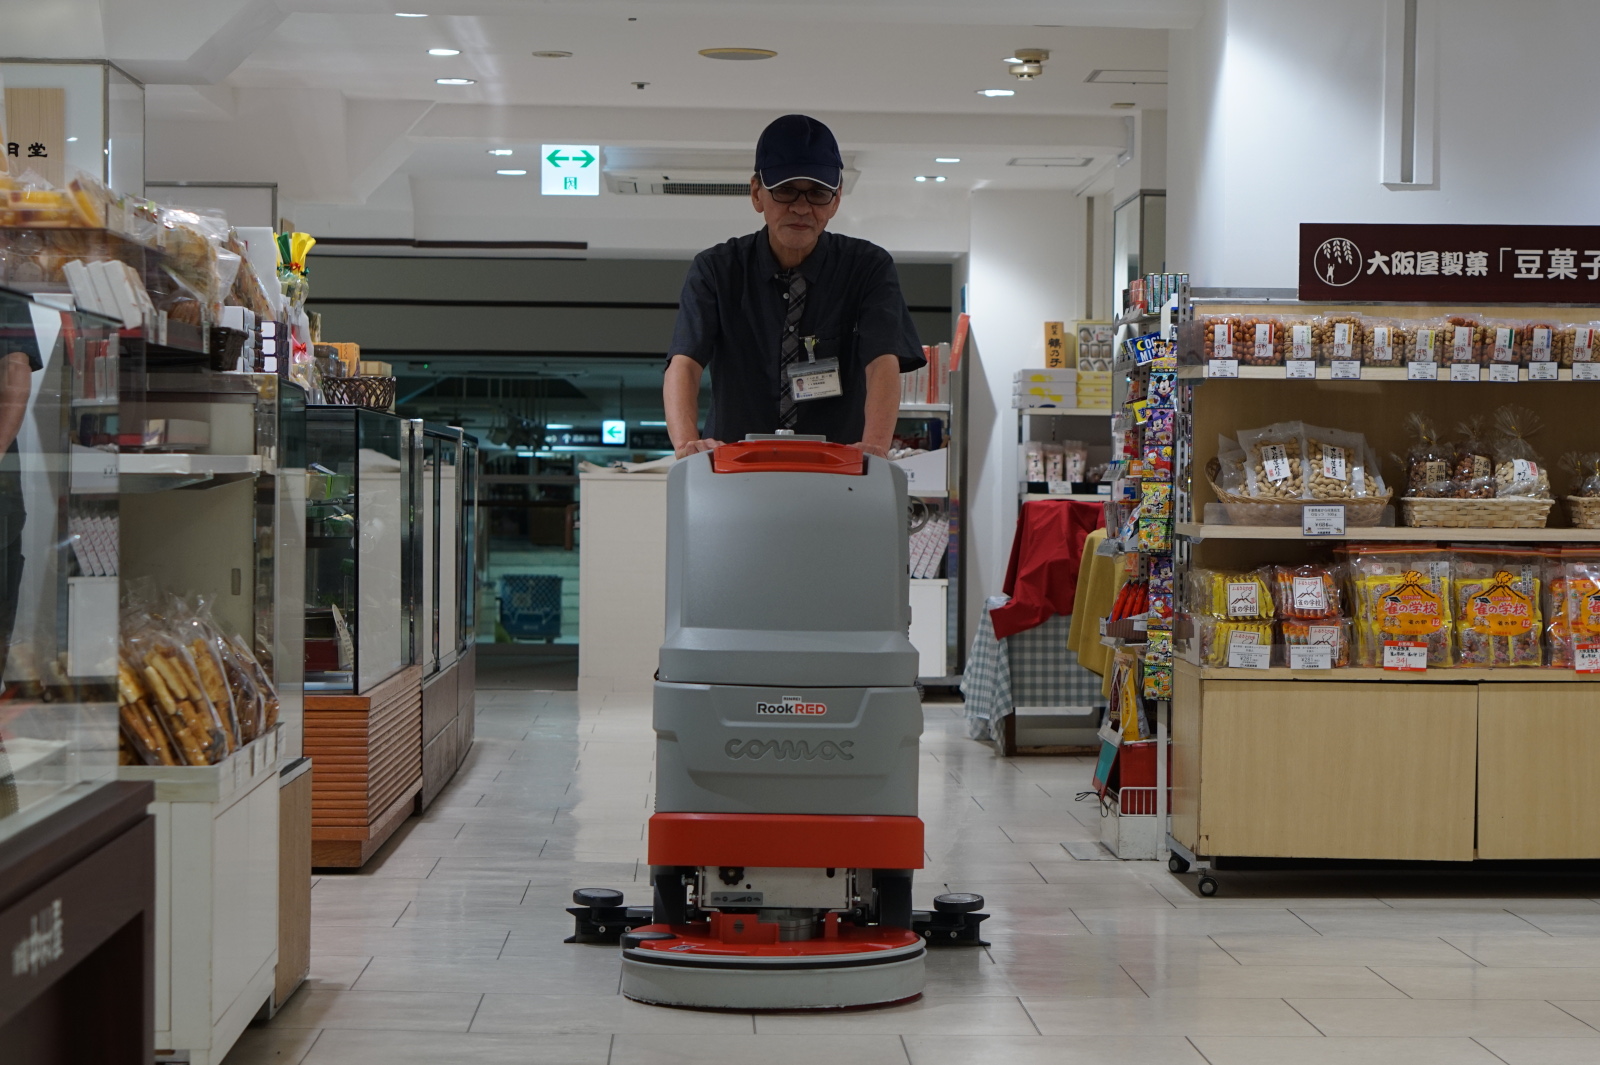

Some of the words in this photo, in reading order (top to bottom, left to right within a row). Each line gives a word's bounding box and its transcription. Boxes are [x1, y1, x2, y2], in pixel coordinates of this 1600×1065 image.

[1367, 251, 1489, 277] 大阪屋製菓
[1298, 599, 1322, 607] 雀の学校
[1231, 604, 1256, 613] 雀の学校
[1385, 601, 1438, 615] 雀の学校
[1473, 602, 1527, 616] 雀の学校
[1432, 618, 1440, 626] 12
[1521, 619, 1530, 627] 12
